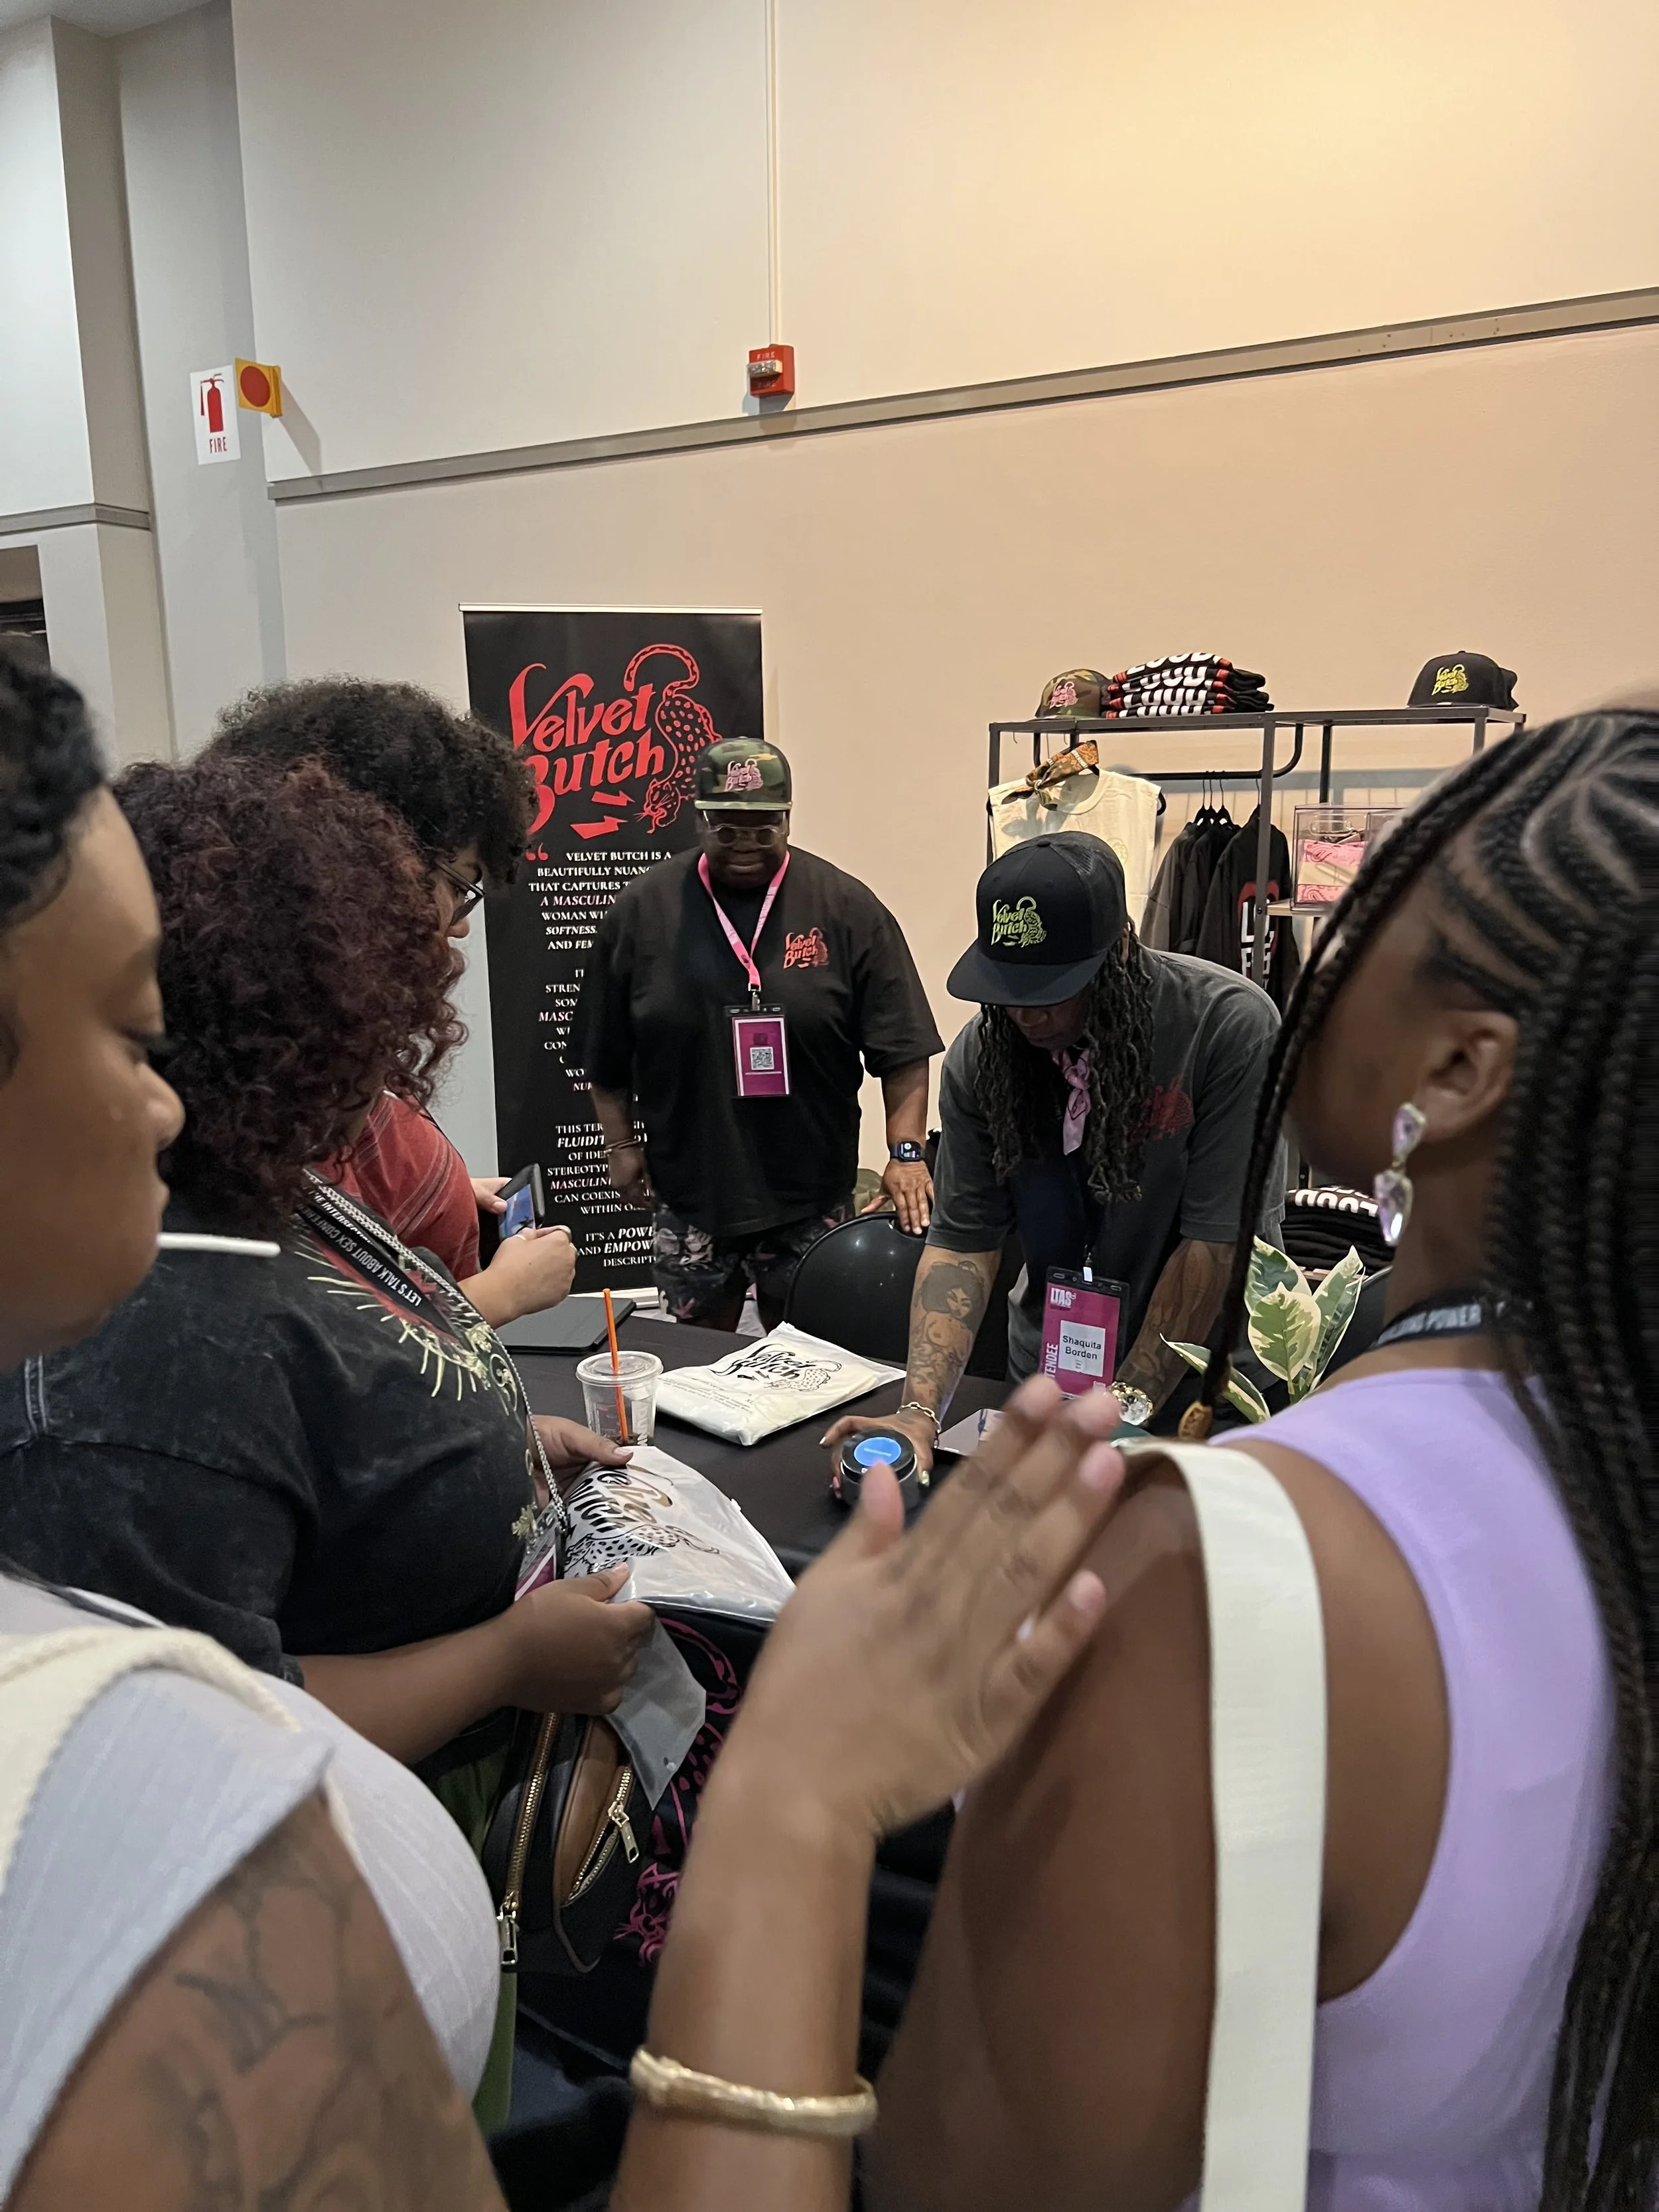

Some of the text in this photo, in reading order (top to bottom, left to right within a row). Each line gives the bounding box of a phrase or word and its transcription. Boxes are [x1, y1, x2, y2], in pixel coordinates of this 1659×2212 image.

[757, 351, 775, 360] FIRE
[209, 437, 227, 454] FIRE
[509, 663, 656, 751] Velvet
[566, 851, 672, 861] VELVET BUTCH IS A
[538, 867, 611, 877] BEAUTIFULLY
[528, 882, 559, 892] THAT
[562, 881, 621, 891] CAPTURES
[540, 895, 617, 907] A MASCULIN
[541, 911, 608, 921] WOMAN WI
[993, 899, 1025, 922] Velvet
[991, 920, 1027, 946] Butch
[547, 940, 572, 950] AND
[786, 932, 817, 951] Velvet
[784, 945, 818, 969] Butch
[545, 984, 581, 993] STREN
[539, 1011, 573, 1022] MASC
[555, 1123, 603, 1134] THIS TER
[557, 1135, 605, 1148] FLUIDIT
[569, 1151, 607, 1161] OF IDE
[547, 1164, 609, 1176] STEREOTYP
[555, 1191, 620, 1203] CAN COEXIS
[581, 1204, 622, 1215] WITHIN
[586, 1232, 605, 1242] IT'S
[335, 1235, 357, 1252] SEX
[579, 1240, 653, 1255] AND EMPOW
[351, 1248, 384, 1274] ABOUT
[377, 1268, 401, 1290] TALK
[398, 1284, 422, 1307] LET'S
[1062, 1335, 1102, 1350] Shaquita
[1065, 1347, 1098, 1360] Borden
[1044, 1343, 1058, 1378] TENDEE
